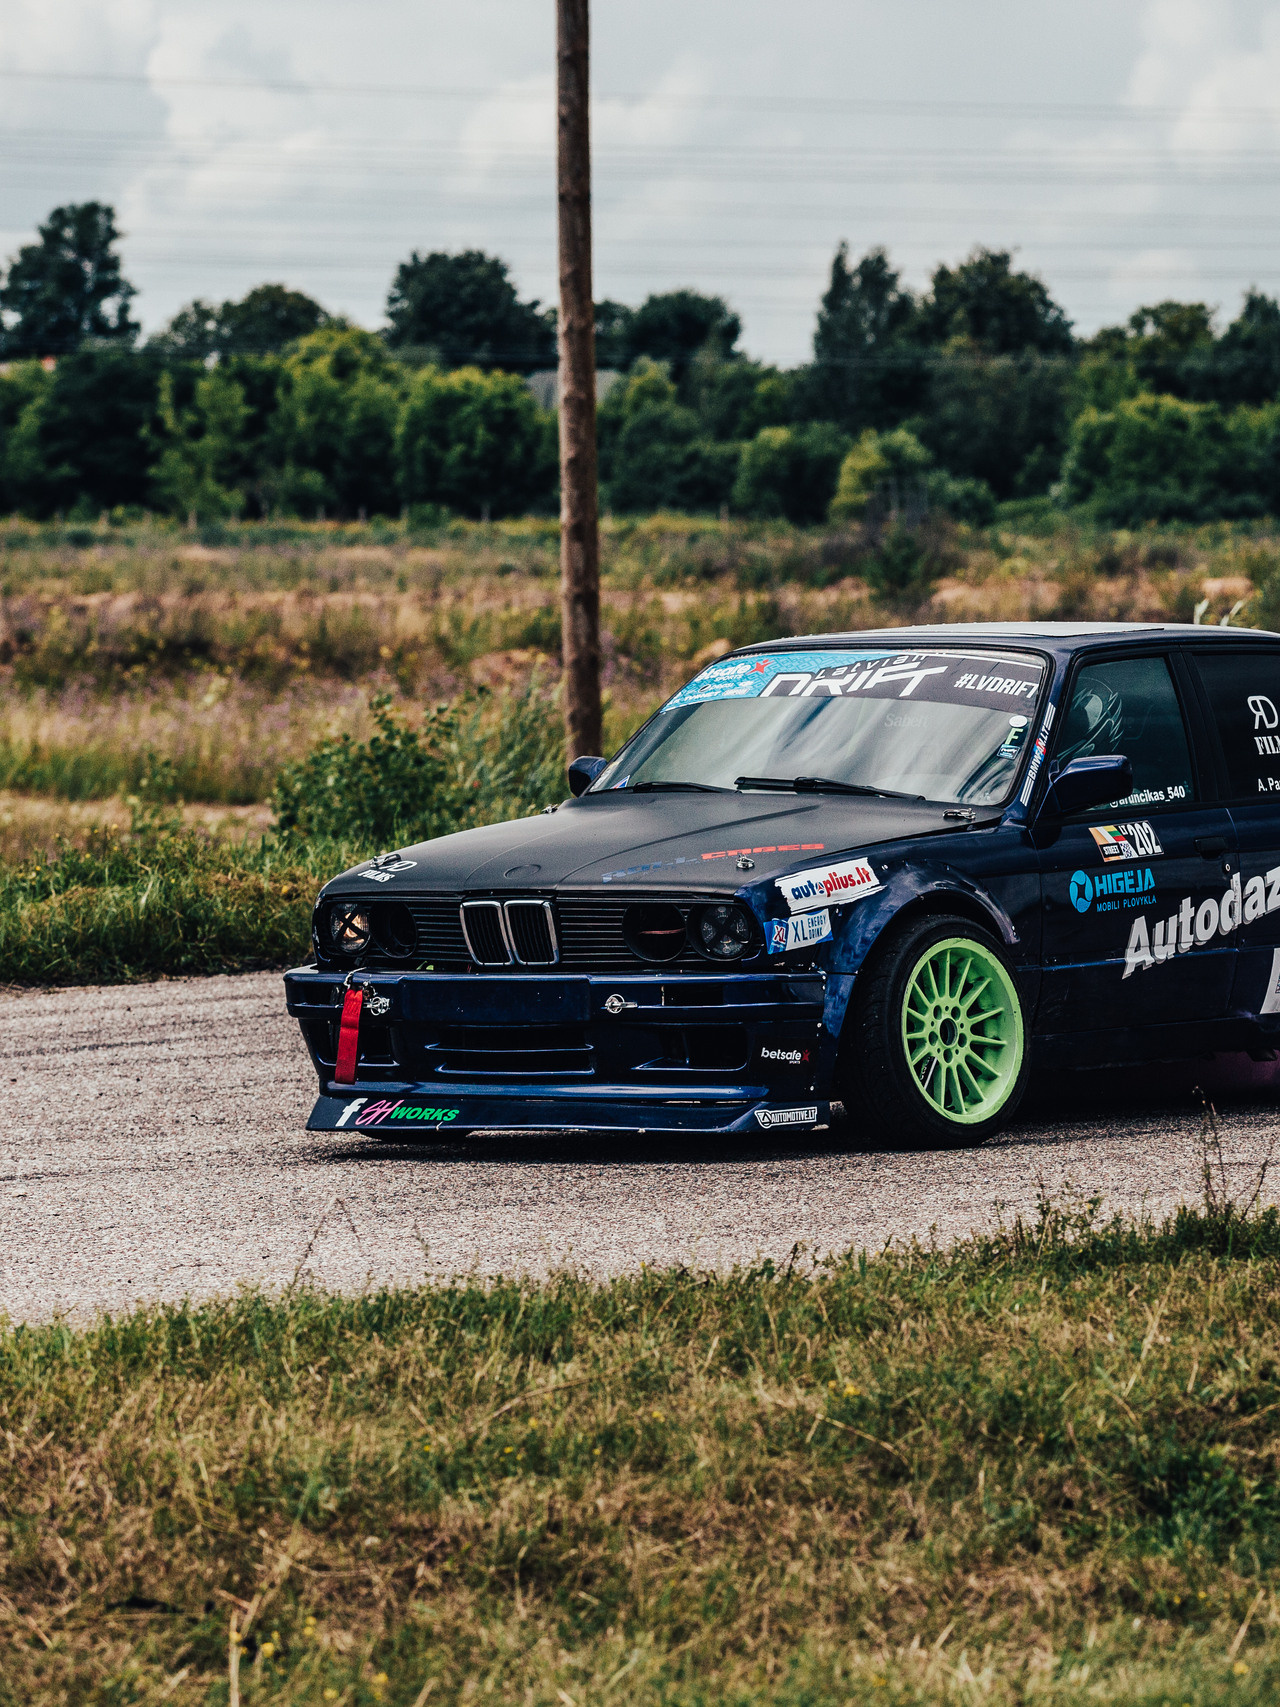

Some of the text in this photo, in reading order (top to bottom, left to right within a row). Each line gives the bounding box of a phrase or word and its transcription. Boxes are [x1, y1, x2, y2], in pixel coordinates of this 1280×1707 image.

[760, 662, 948, 697] DRIFT
[954, 673, 1039, 699] #LVDRIFT
[1258, 778, 1267, 792] A.
[1127, 822, 1162, 855] 202
[1096, 895, 1156, 912] MOBILI PLOVYKLA
[808, 915, 826, 928] ENERGY
[792, 920, 808, 942] XL
[808, 927, 823, 939] DRINK
[761, 1047, 801, 1060] betsafe
[771, 1109, 815, 1123] AUTOMOTIVE.LT
